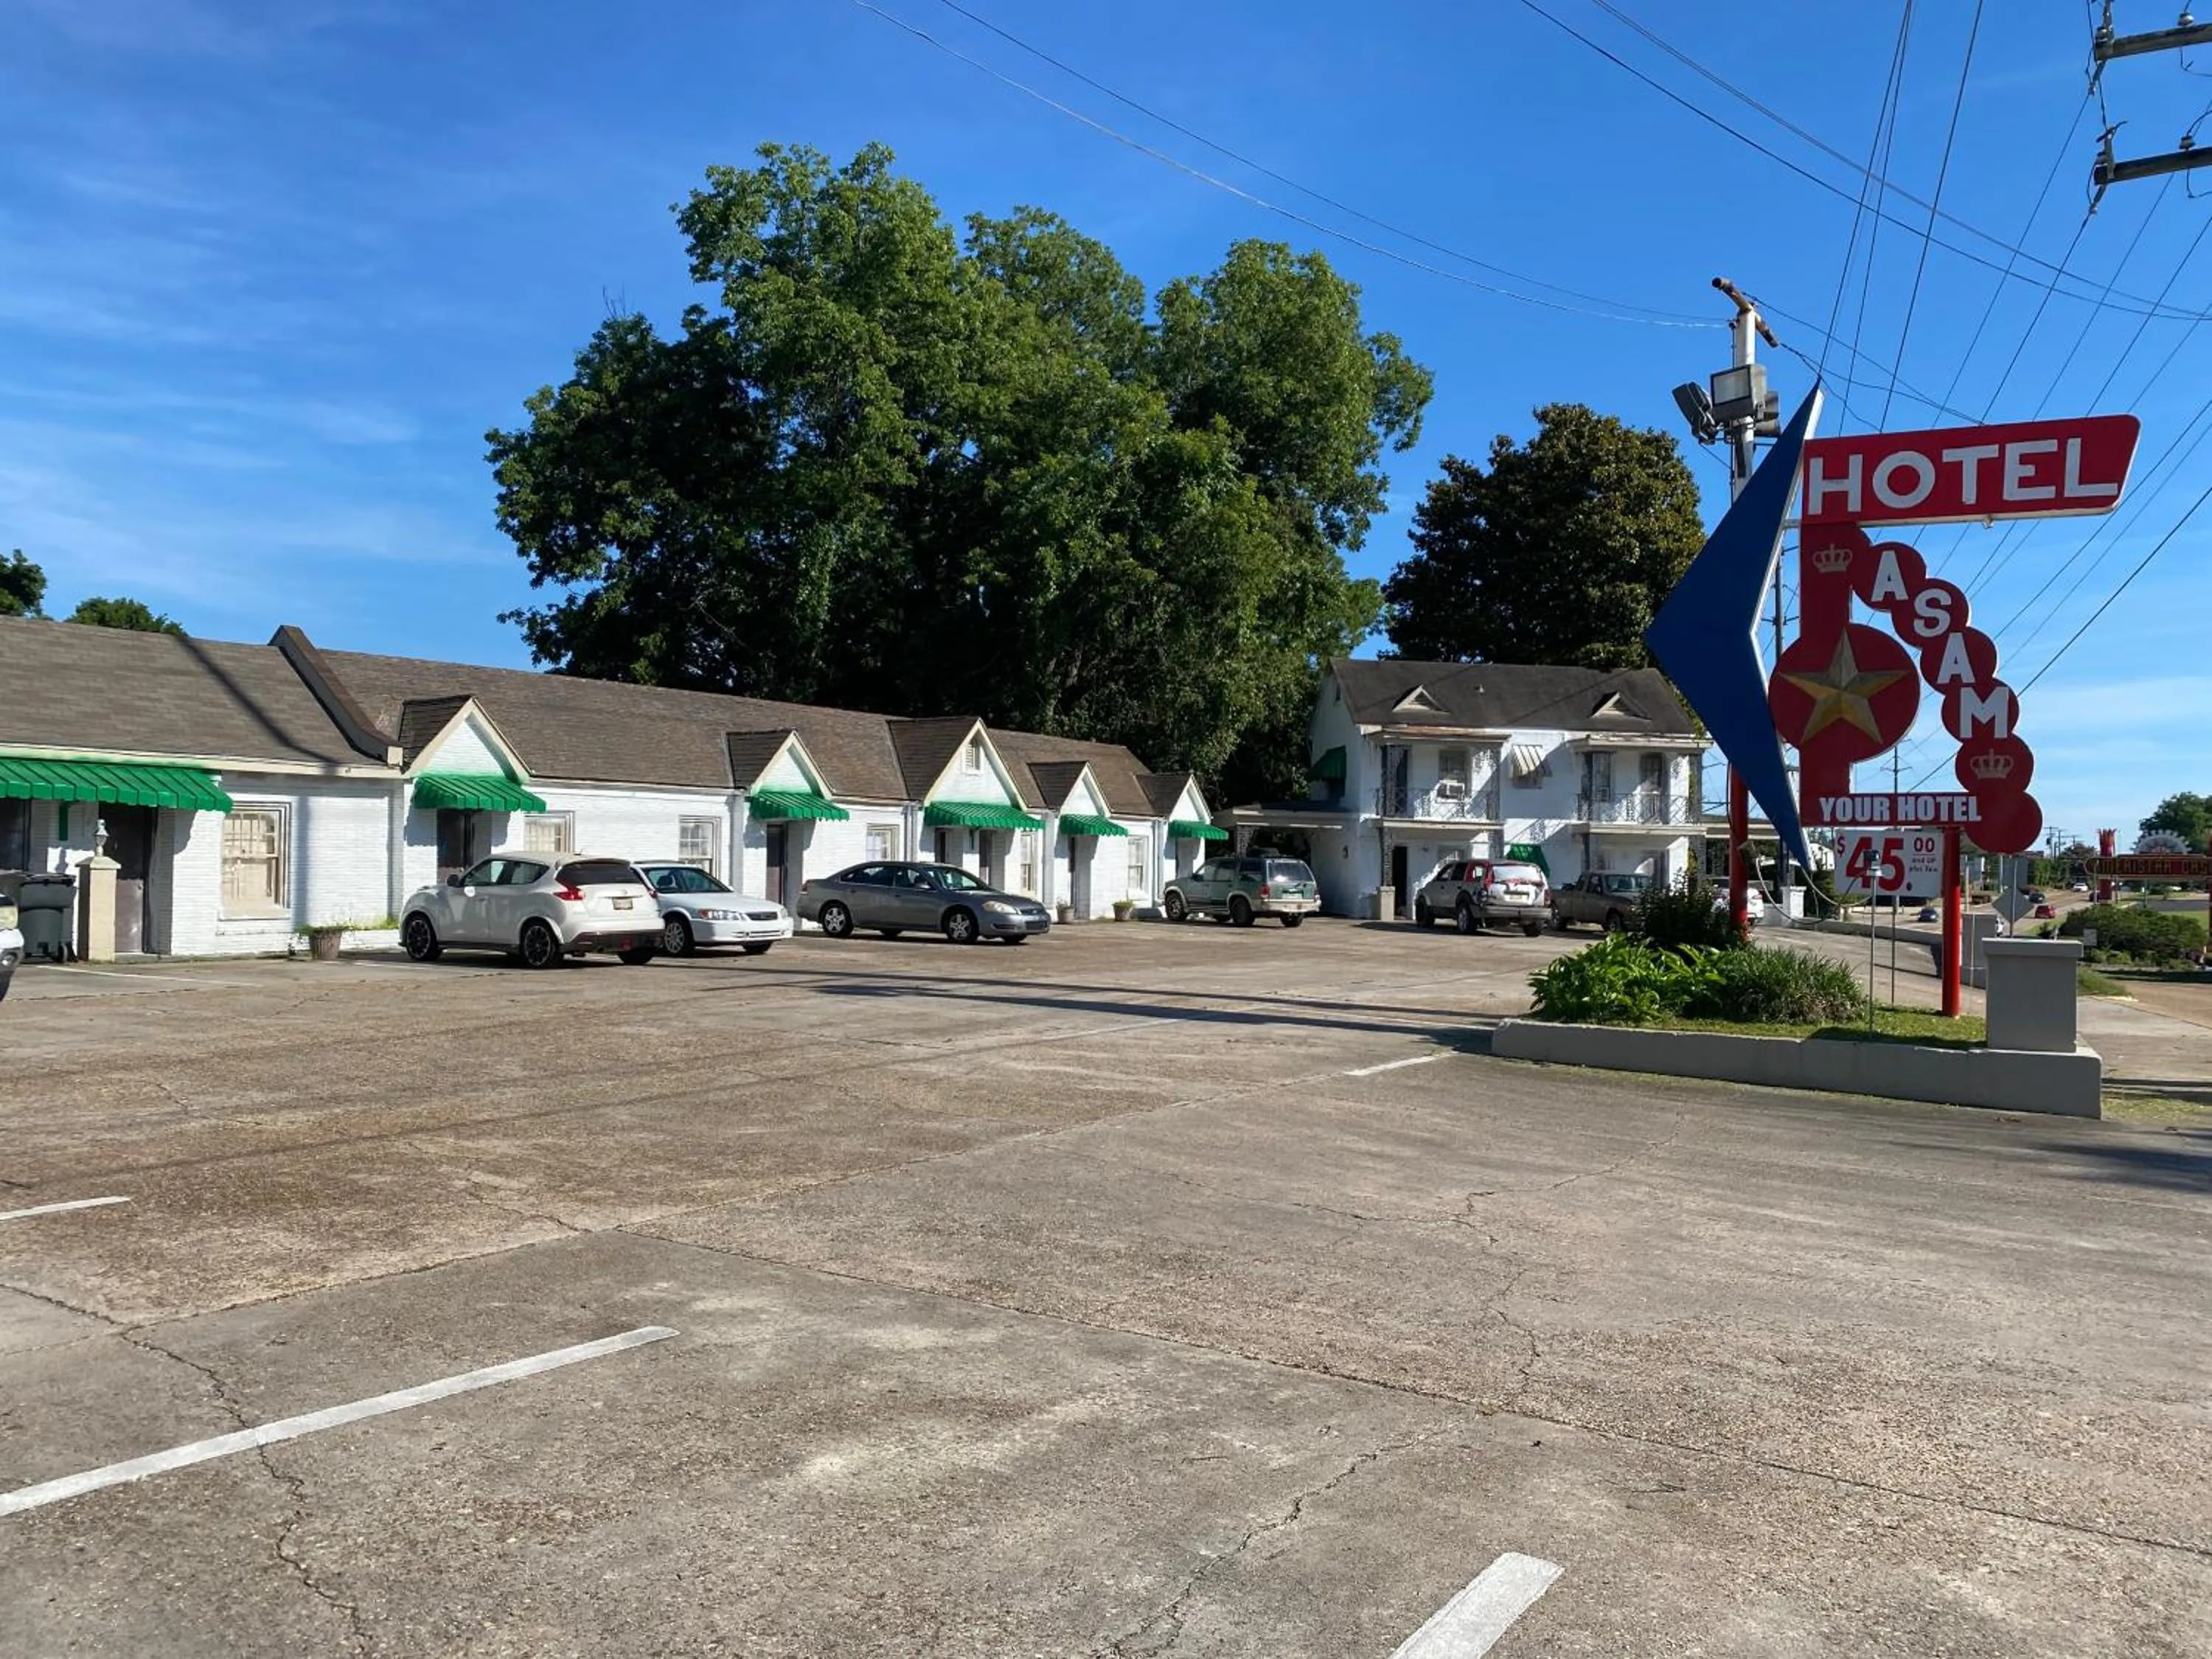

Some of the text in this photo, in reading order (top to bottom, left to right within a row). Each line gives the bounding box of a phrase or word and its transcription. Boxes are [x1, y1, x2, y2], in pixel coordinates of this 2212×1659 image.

[1808, 437, 2118, 515] HOTEL
[1819, 796, 1981, 822] YOUR HOTEL
